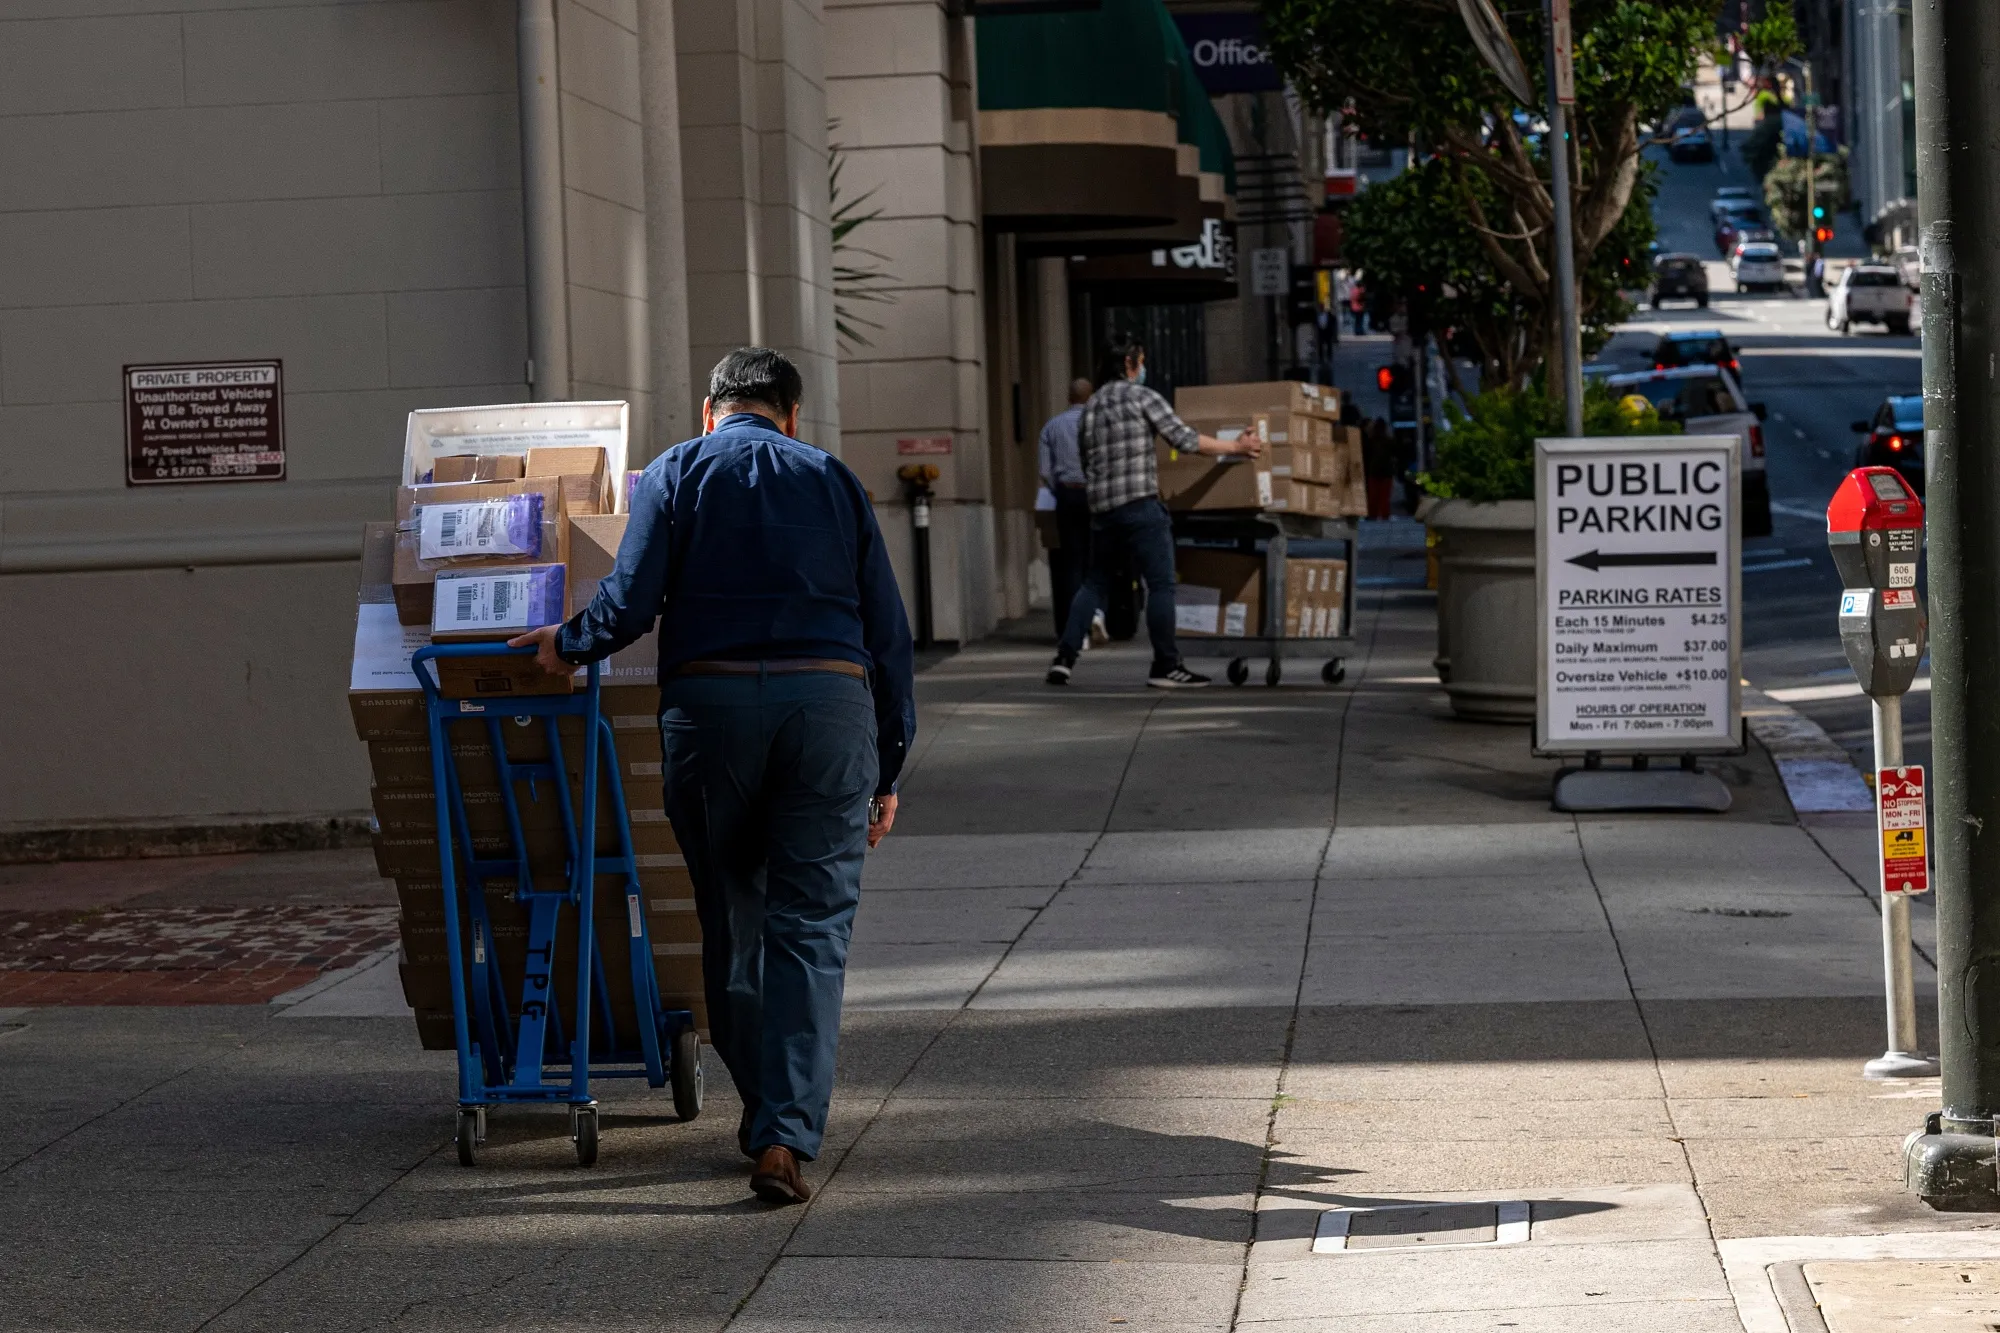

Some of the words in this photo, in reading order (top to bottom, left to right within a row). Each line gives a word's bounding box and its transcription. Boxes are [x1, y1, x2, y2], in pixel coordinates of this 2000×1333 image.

[137, 373, 191, 386] PRIVATE
[196, 370, 270, 383] PROPERTY
[135, 390, 216, 403] Unauthorized
[220, 388, 272, 400] Vehicles
[141, 405, 164, 417] Will
[168, 404, 185, 415] Be
[190, 403, 230, 415] Towed
[234, 402, 267, 414] Away
[142, 419, 155, 430] At
[160, 417, 209, 429] Owner's
[213, 416, 268, 429] Expense
[142, 446, 158, 456] For
[162, 445, 192, 456] Towed
[195, 444, 235, 454] Vehicles
[238, 443, 269, 453] Phone
[156, 467, 168, 477] Or
[1557, 461, 1721, 497] PUBLIC
[1558, 504, 1722, 534] PARKING
[1894, 566, 1909, 574] 606
[1891, 576, 1913, 585] 03150
[1559, 588, 1649, 605] PARKING
[1656, 587, 1721, 603] RATES
[1555, 616, 1588, 628] Each
[1594, 615, 1609, 627] 15
[1612, 614, 1666, 627] Minutes
[1691, 613, 1727, 626] $4.25
[1555, 642, 1588, 656] Daily
[1592, 641, 1658, 654] Maximum
[1684, 640, 1727, 653] $37.00
[611, 666, 658, 677] MSUN
[1556, 671, 1614, 683] Oversize
[1618, 669, 1667, 682] Vehicle
[1675, 668, 1727, 681] +$10.00
[1576, 704, 1617, 715] HOURS
[1620, 704, 1635, 714] OF
[1639, 703, 1706, 713] OPERATION
[1570, 721, 1593, 731] Mon
[1603, 720, 1618, 730] Fri
[1624, 720, 1664, 730] 7:00am
[1673, 718, 1714, 730] 7:00pm
[1884, 800, 1896, 808] NO
[1898, 799, 1921, 807] STOPPING
[1909, 809, 1920, 817] FRI
[522, 940, 552, 1021] TPG
